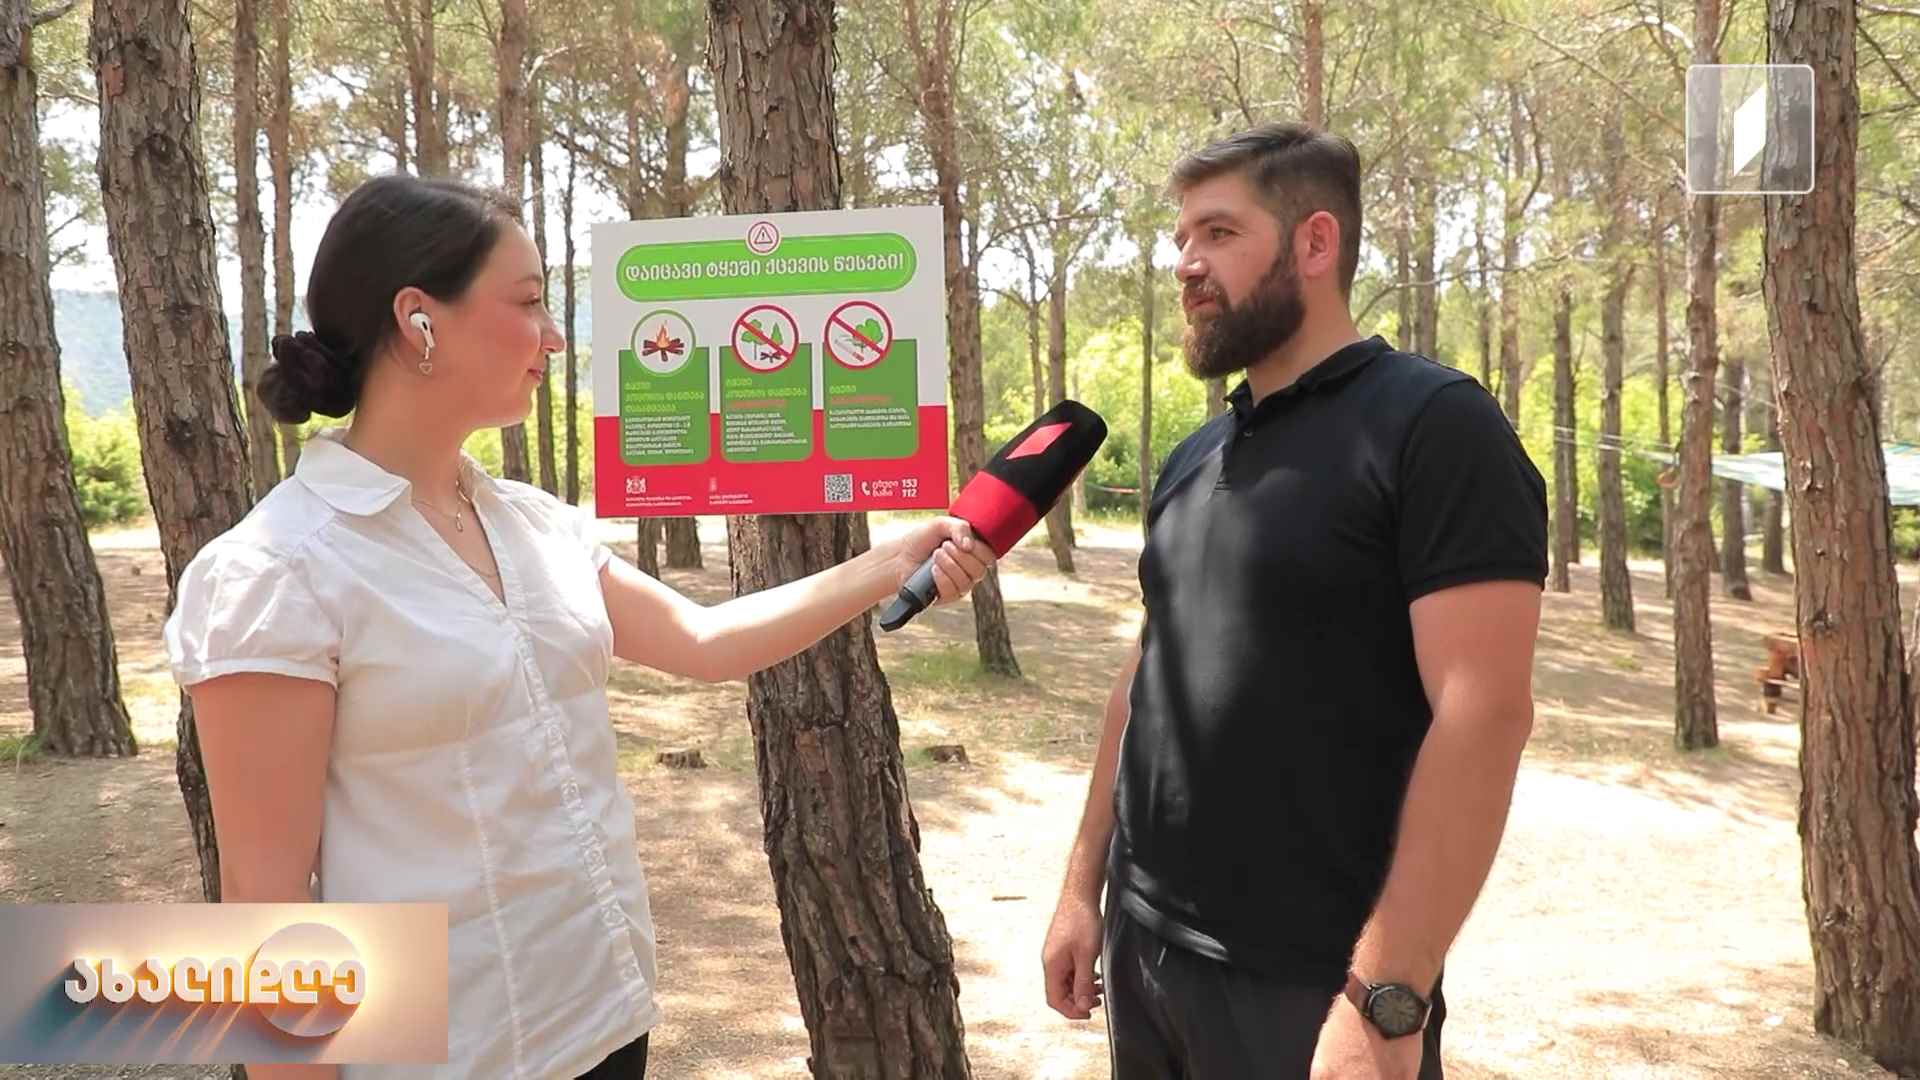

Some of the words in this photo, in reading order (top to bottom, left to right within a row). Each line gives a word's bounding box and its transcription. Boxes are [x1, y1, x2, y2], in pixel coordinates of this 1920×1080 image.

[625, 262, 702, 281] დაიცავი
[706, 259, 761, 278] ტყეში
[765, 256, 830, 275] ქცევის
[833, 253, 904, 272] წესები!
[901, 479, 918, 488] 153
[902, 488, 917, 498] 112
